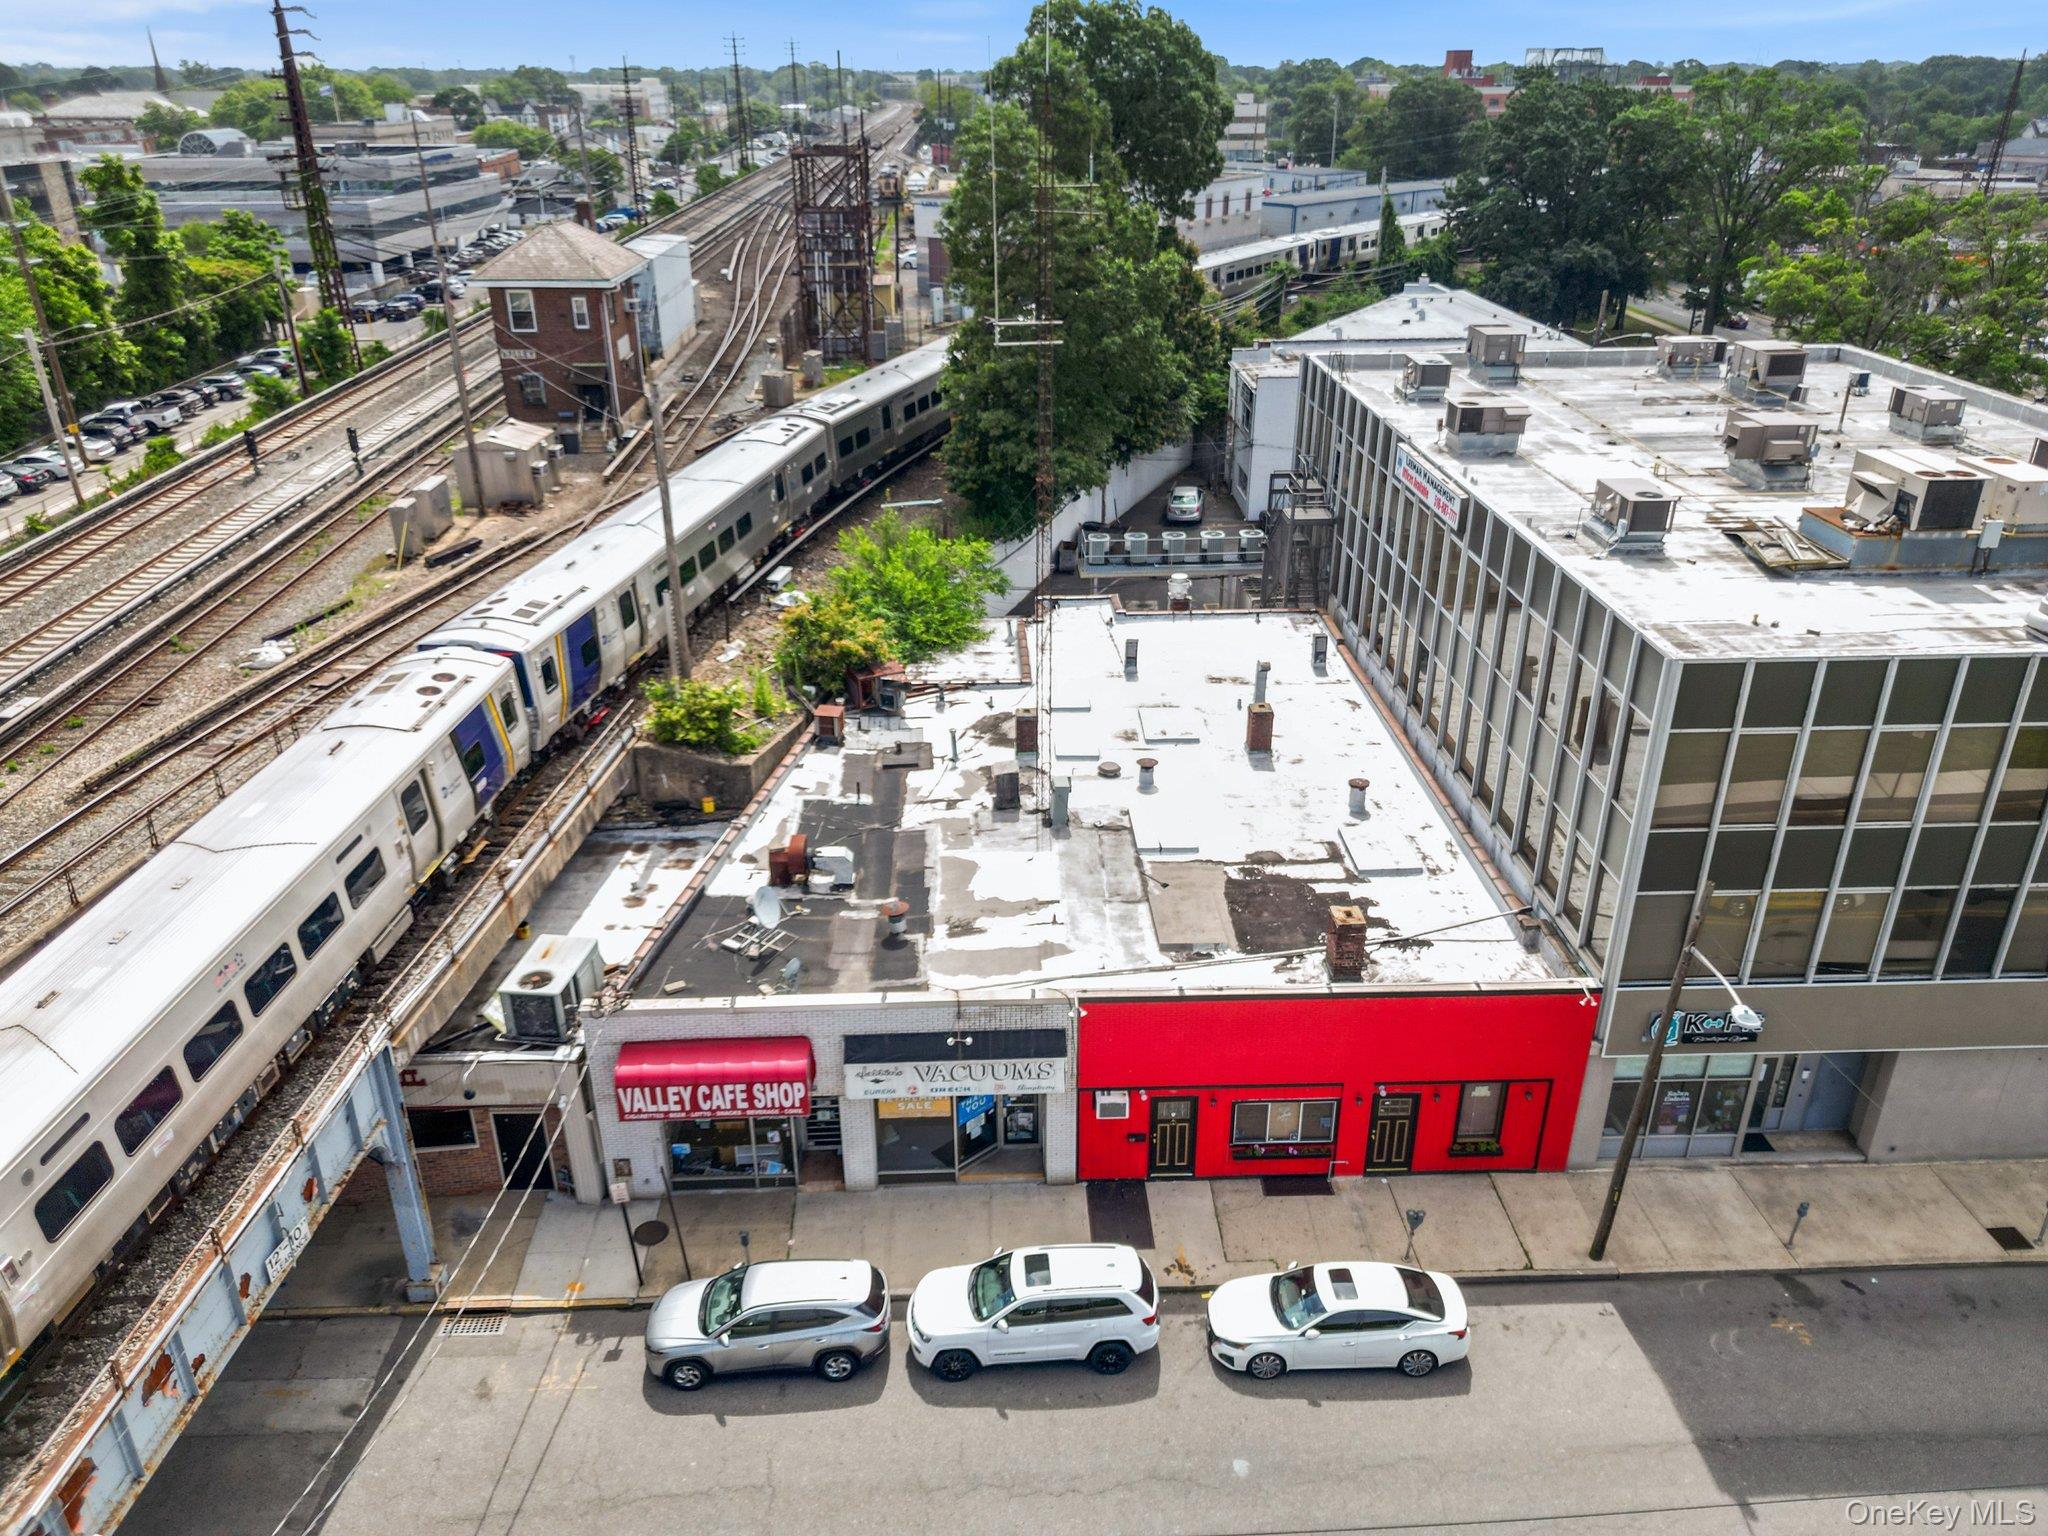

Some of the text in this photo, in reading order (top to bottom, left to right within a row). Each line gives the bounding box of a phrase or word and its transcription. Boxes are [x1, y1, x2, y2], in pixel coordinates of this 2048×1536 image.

[1423, 470, 1456, 507] MANAGEMENT
[1683, 1012, 1707, 1033] K
[914, 1061, 1055, 1082] VACUUMS
[617, 1082, 806, 1113] VALLEY CAFE SHOP
[864, 1088, 896, 1096] EUREKA
[897, 1101, 932, 1110] SALE
[965, 1096, 986, 1113] YOU
